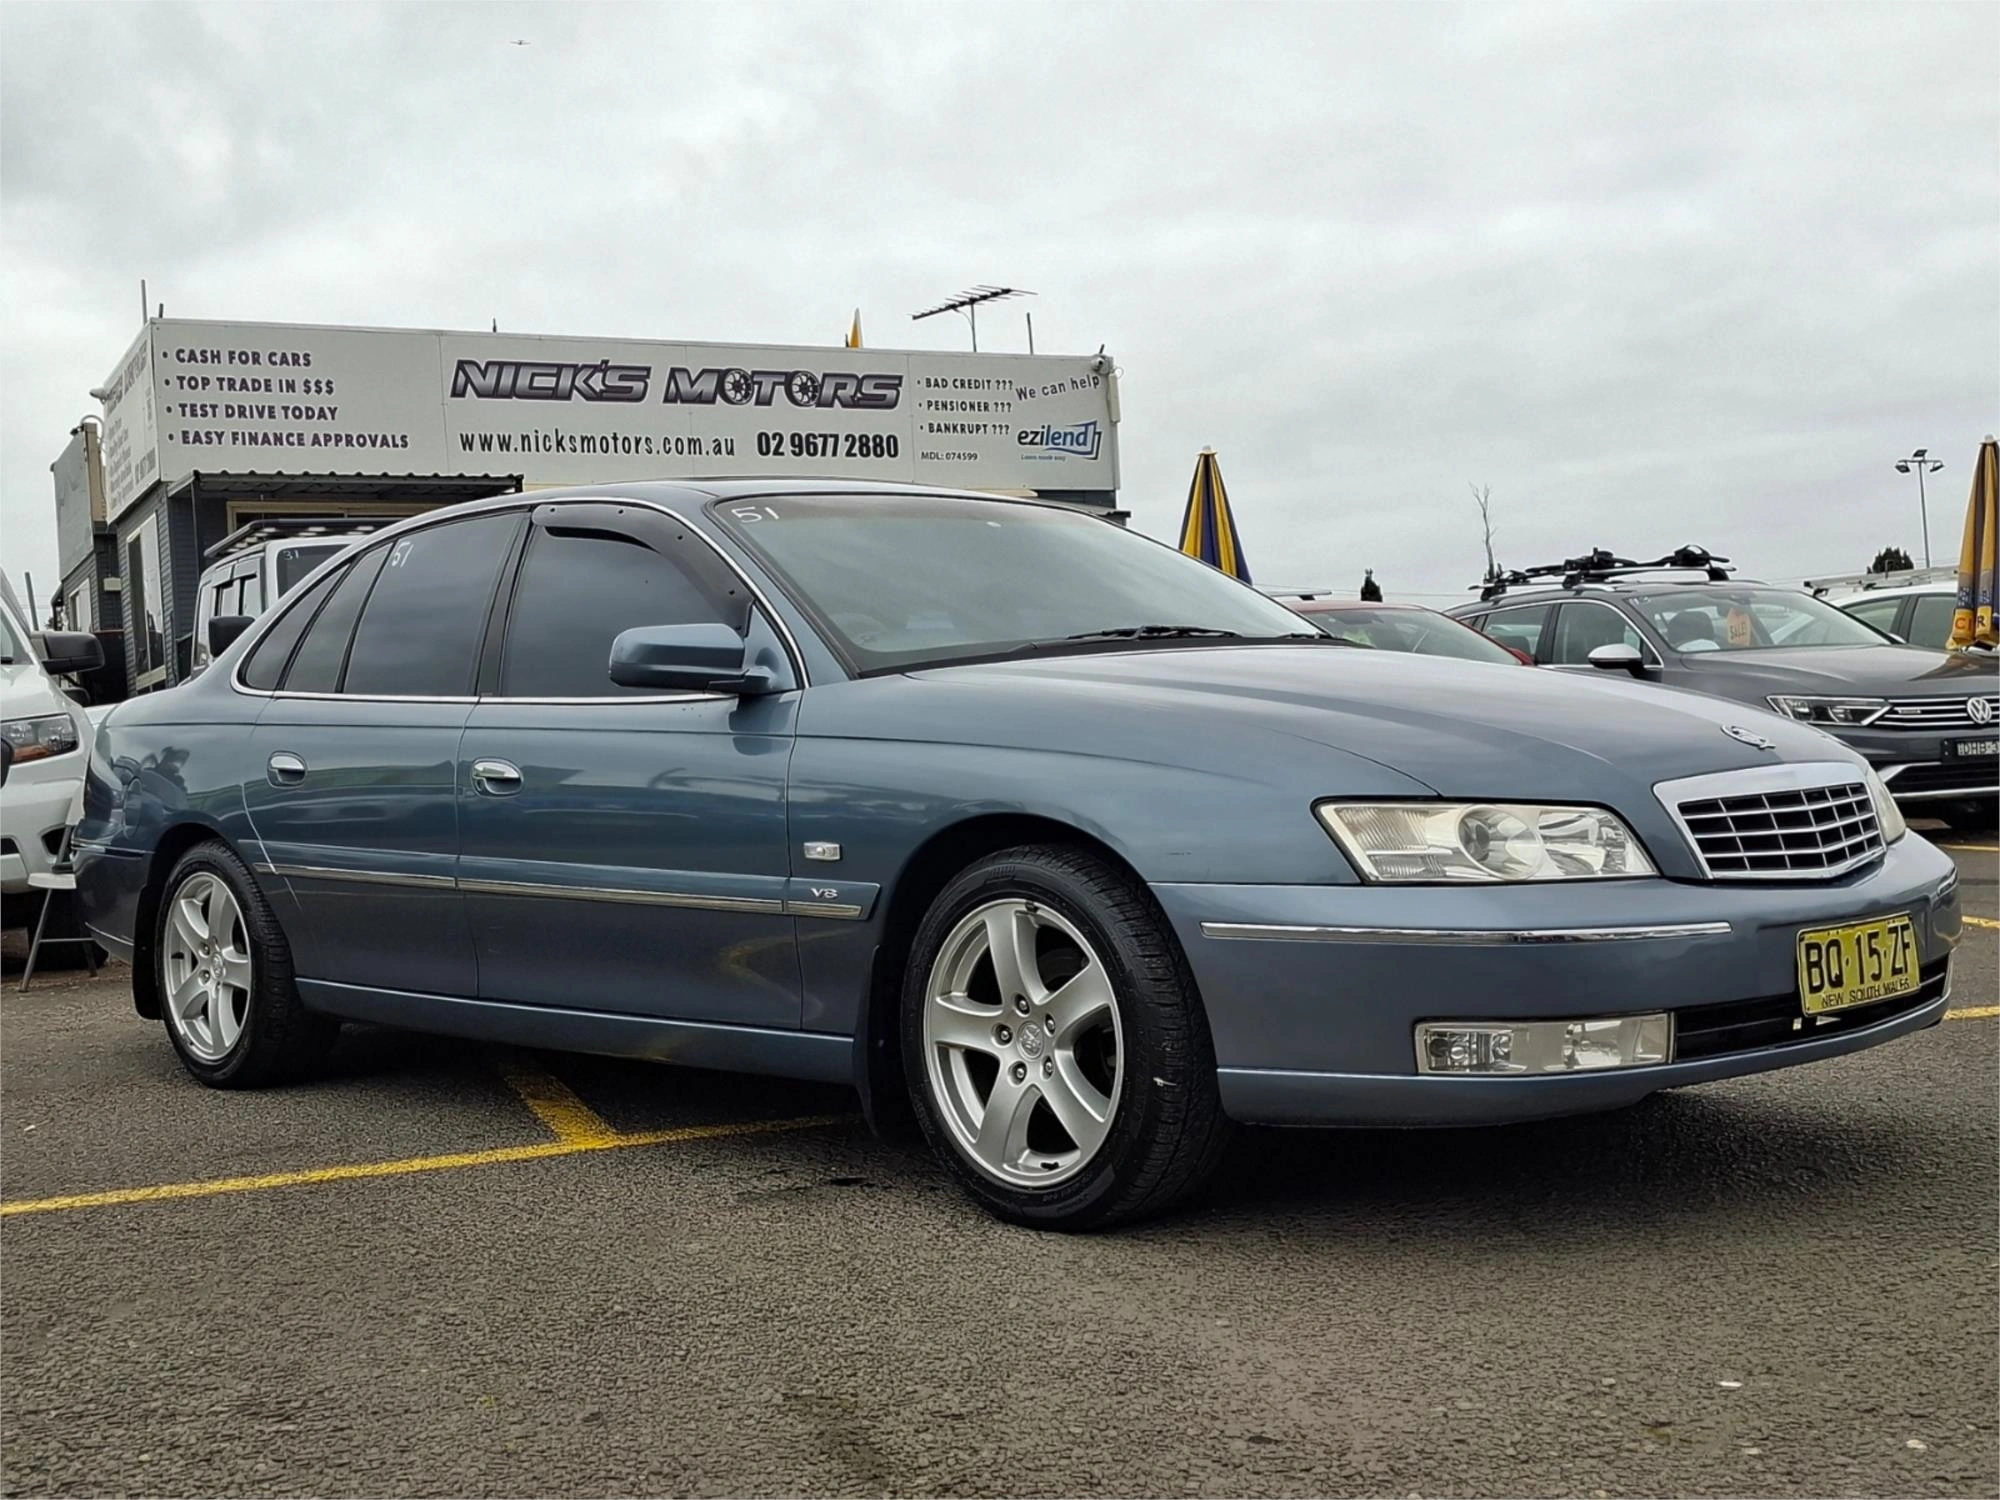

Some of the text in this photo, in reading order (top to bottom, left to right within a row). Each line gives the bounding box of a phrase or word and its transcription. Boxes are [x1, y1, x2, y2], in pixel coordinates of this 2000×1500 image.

[175, 349, 312, 367] CASH FOR CARS
[176, 375, 335, 396] TOP TRADE IN $$$
[450, 359, 904, 410] NICK'S MOTORS
[925, 377, 1013, 391] BAD CREDIT ???
[1015, 373, 1100, 402] We can help
[178, 403, 339, 421] TEST DRIVE TODAY
[927, 399, 1012, 413] PENSIONER ???
[928, 422, 1010, 436] BANKRUPT ???
[1017, 422, 1090, 447] ezilend
[181, 430, 409, 449] EASY FINANCE APPROVALS
[459, 428, 735, 457] www.nicksmotors.com.au
[756, 431, 899, 458] 02 9677 2880
[921, 451, 978, 461] MDL: 074599
[731, 506, 779, 523] 51
[392, 541, 414, 568] 51
[1821, 992, 1844, 1008] NEW
[1849, 984, 1881, 1003] SOUTH
